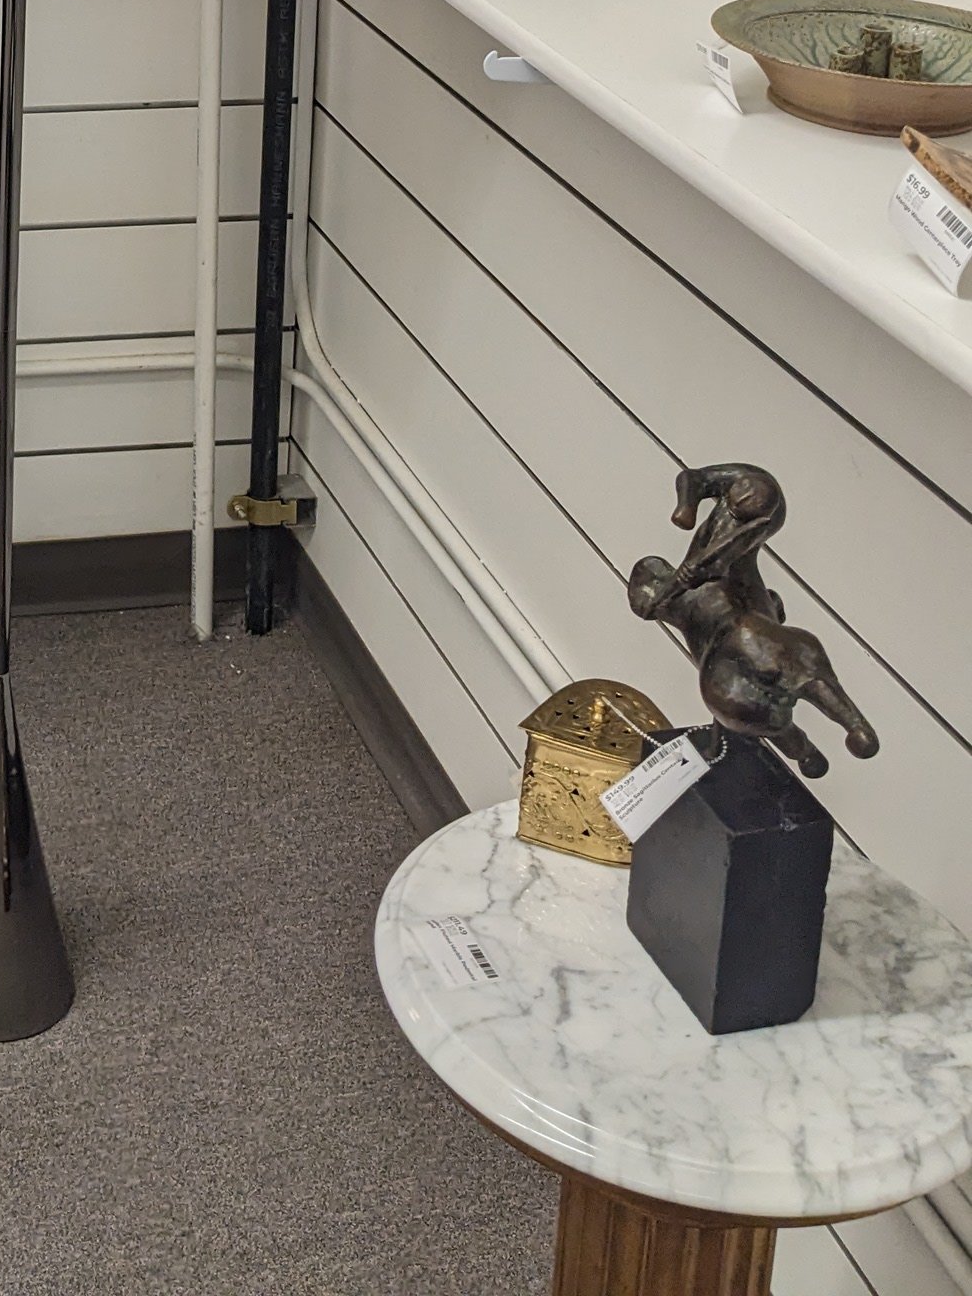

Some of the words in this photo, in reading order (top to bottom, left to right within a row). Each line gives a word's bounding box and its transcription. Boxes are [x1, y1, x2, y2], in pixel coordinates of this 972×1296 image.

[906, 173, 931, 200] $16.99
[910, 208, 924, 227] Wood
[923, 225, 952, 257] Centerpiece
[950, 253, 962, 268] Tray
[605, 775, 635, 802] $149.99
[615, 798, 634, 816] Bronze
[618, 797, 644, 821] Sculpture
